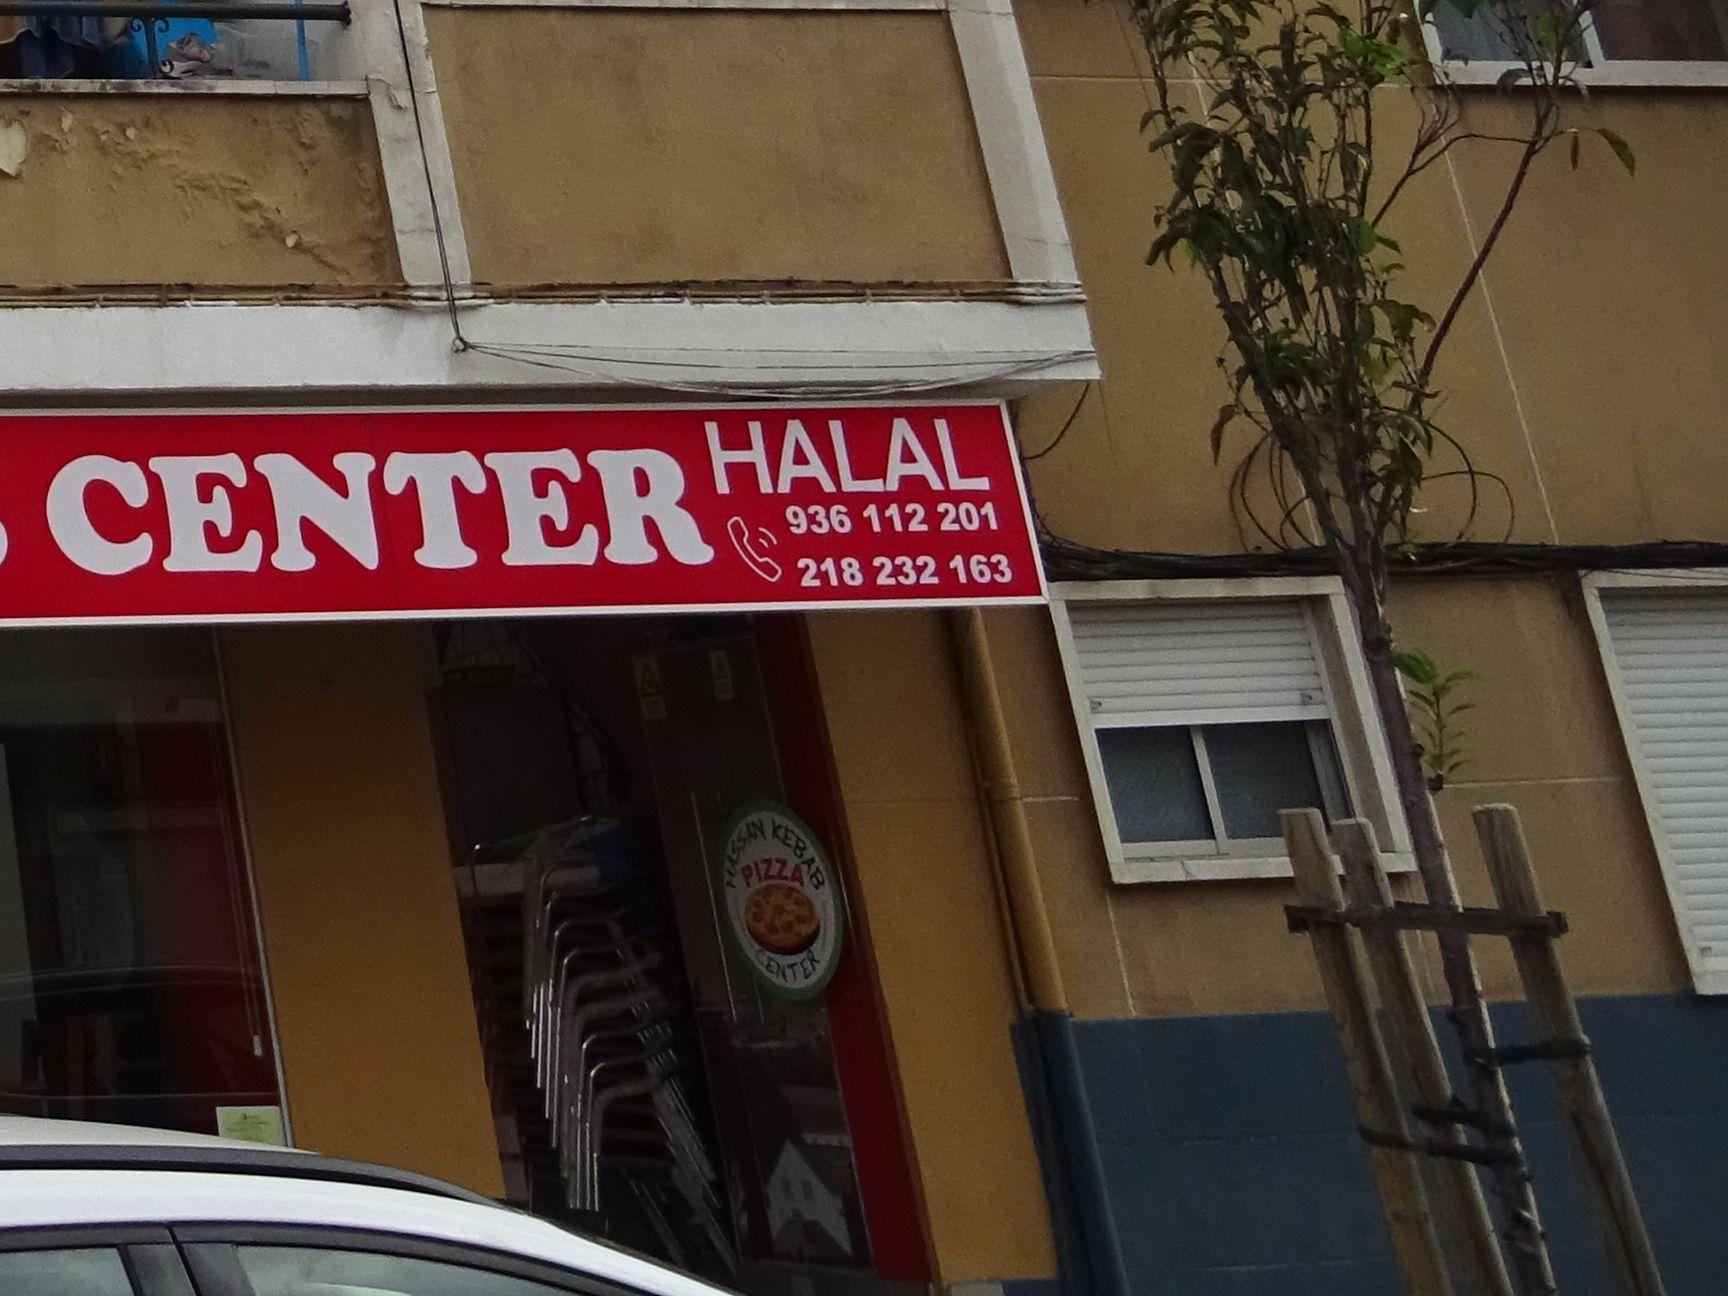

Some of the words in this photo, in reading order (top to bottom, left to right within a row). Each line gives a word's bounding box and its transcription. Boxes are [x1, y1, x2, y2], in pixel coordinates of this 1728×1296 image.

[705, 418, 989, 495] HALAL
[45, 448, 714, 575] CENTER
[786, 505, 851, 534] 936
[864, 503, 928, 532] 112
[937, 501, 998, 531] 201
[797, 557, 863, 587] 218
[873, 556, 938, 585] 232
[949, 554, 1012, 583] 163
[741, 859, 805, 887] PIZZA
[771, 820, 826, 891] KEBAB
